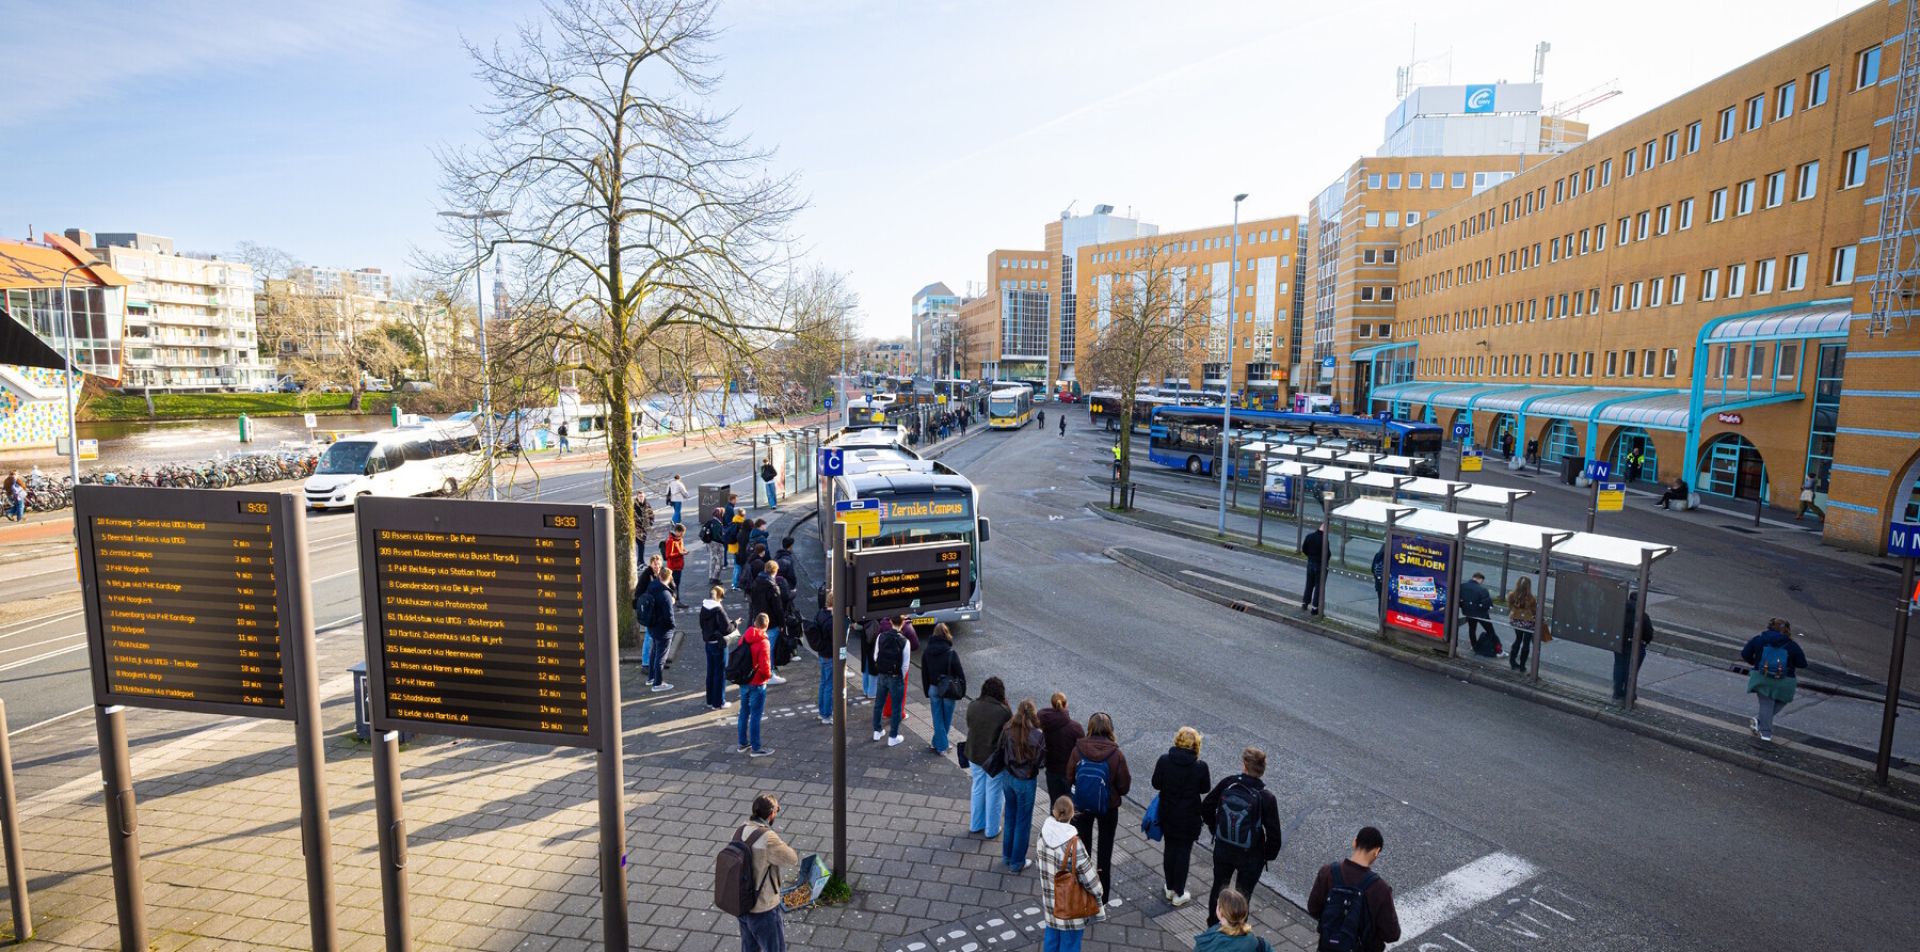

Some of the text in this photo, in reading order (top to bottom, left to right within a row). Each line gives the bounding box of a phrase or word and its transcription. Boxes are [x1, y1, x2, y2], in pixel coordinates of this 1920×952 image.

[828, 456, 840, 470] C
[1597, 466, 1607, 476] N
[248, 503, 268, 513] 9:33
[892, 502, 928, 517] Zernike
[929, 502, 963, 516] Campus
[554, 517, 576, 527] 9:33
[381, 530, 390, 538] 50
[391, 531, 410, 540] Assen
[413, 532, 423, 540] via
[424, 533, 444, 541] Haren
[450, 534, 458, 542] De
[460, 534, 476, 543] Punt
[574, 540, 580, 548] S
[1892, 530, 1905, 548] M
[392, 548, 411, 556] Assen
[413, 549, 457, 559] Kloosterveen
[458, 551, 469, 559] via
[1394, 553, 1406, 564] €5
[1406, 556, 1445, 571] MILJOEN
[408, 565, 435, 575] Reitdiep
[449, 567, 474, 576] Station
[476, 569, 496, 577] Noord
[576, 574, 581, 582] T
[901, 572, 919, 581] Campus
[395, 580, 439, 592] Coendersborg
[537, 588, 542, 597] 7
[880, 587, 899, 595] Zernike
[901, 584, 919, 594] Campus
[445, 600, 488, 610] Protonstraat
[433, 615, 444, 623] via
[467, 618, 504, 628] Oosterpark
[535, 622, 544, 630] 10
[422, 631, 457, 641] Ziekenhuis
[536, 639, 544, 647] 11
[445, 649, 482, 659] Heerenveen
[579, 658, 585, 666] P
[400, 662, 419, 670] Assen
[433, 664, 451, 672] Haren
[463, 666, 483, 675] Annen
[416, 679, 435, 687] Haren
